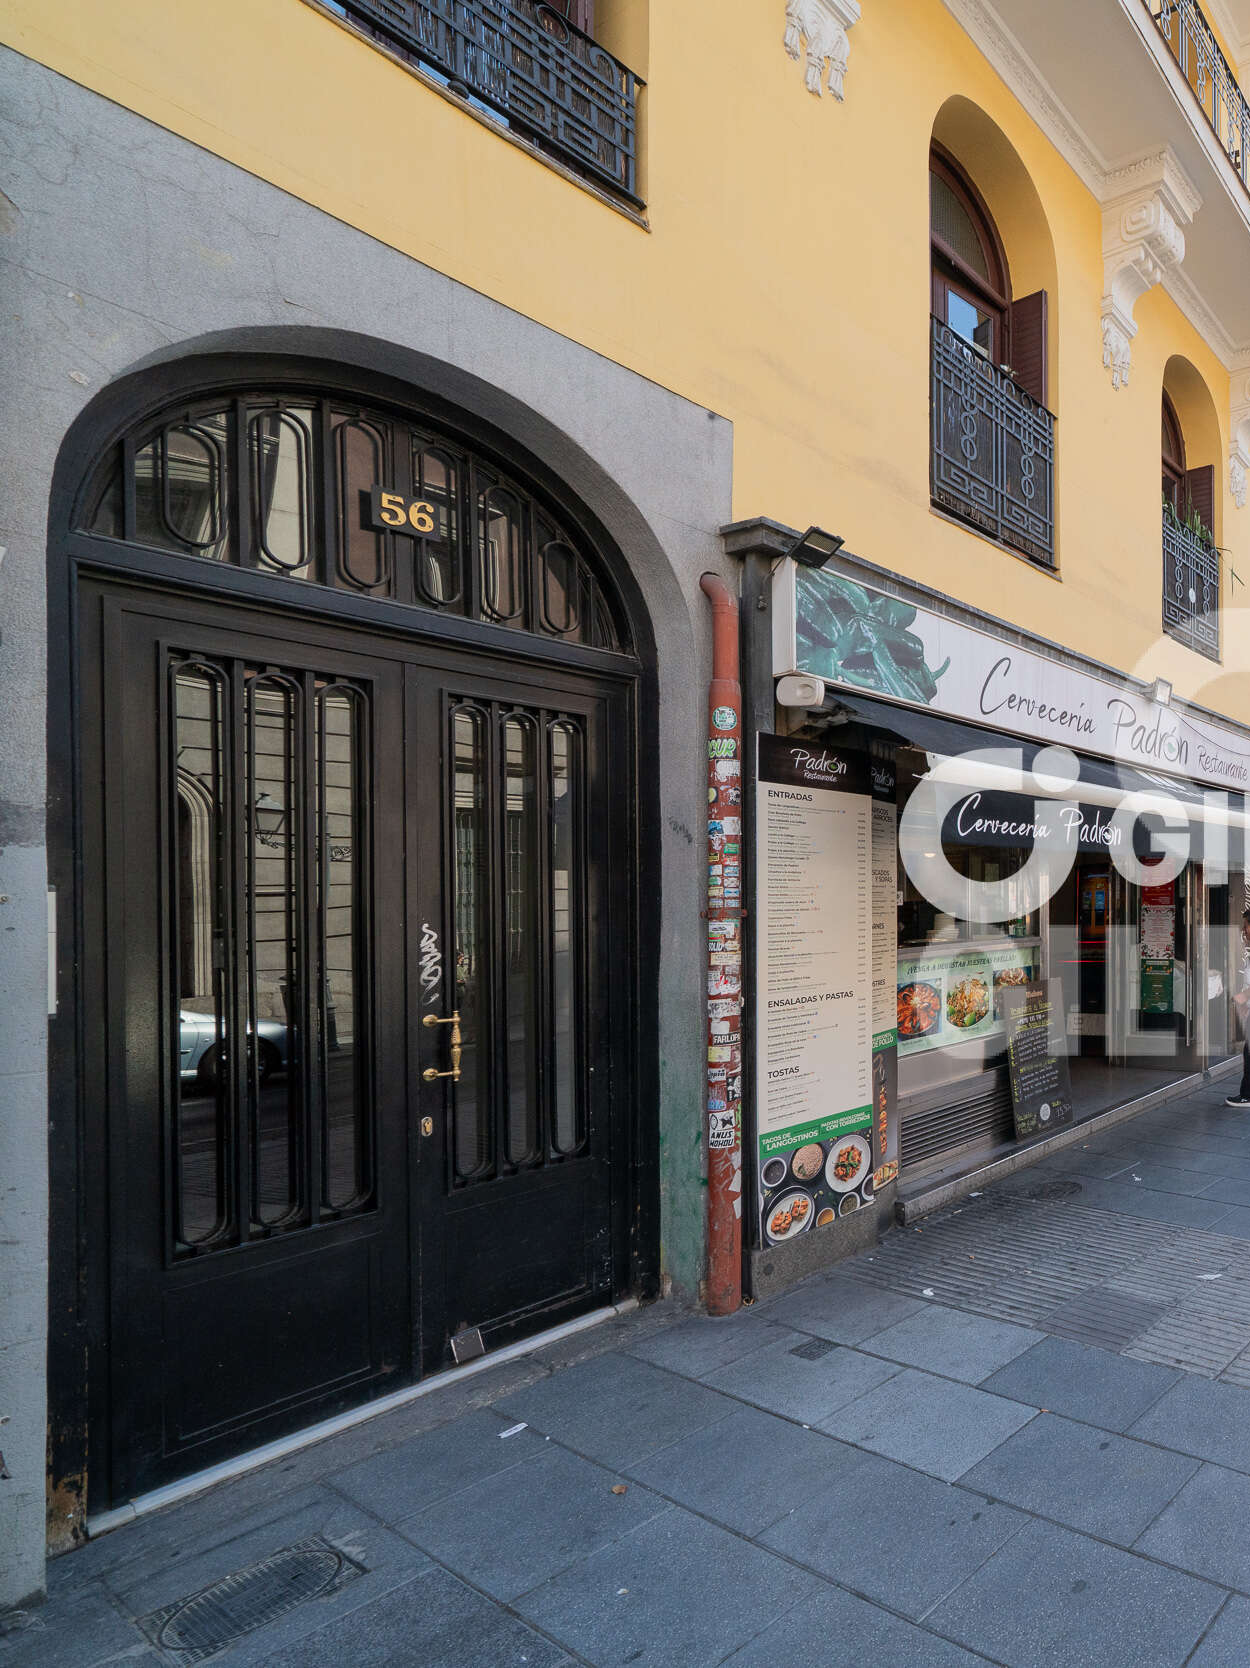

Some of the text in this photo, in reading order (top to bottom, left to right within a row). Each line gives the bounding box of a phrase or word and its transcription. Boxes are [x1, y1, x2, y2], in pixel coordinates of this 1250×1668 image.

[381, 492, 434, 532] 56
[979, 656, 1249, 781] Cervecería Padrón Restaurante
[790, 749, 847, 774] Padrón
[768, 789, 813, 802] ENTRADAS
[957, 793, 1050, 838] Cervecería
[1059, 807, 1122, 846] Padrón
[768, 990, 854, 1008] ENSALADAS Y PASTAS
[768, 1065, 800, 1079] TOSTAS
[762, 1135, 782, 1145] TACOS
[766, 1129, 819, 1151] LANGOSTINOS
